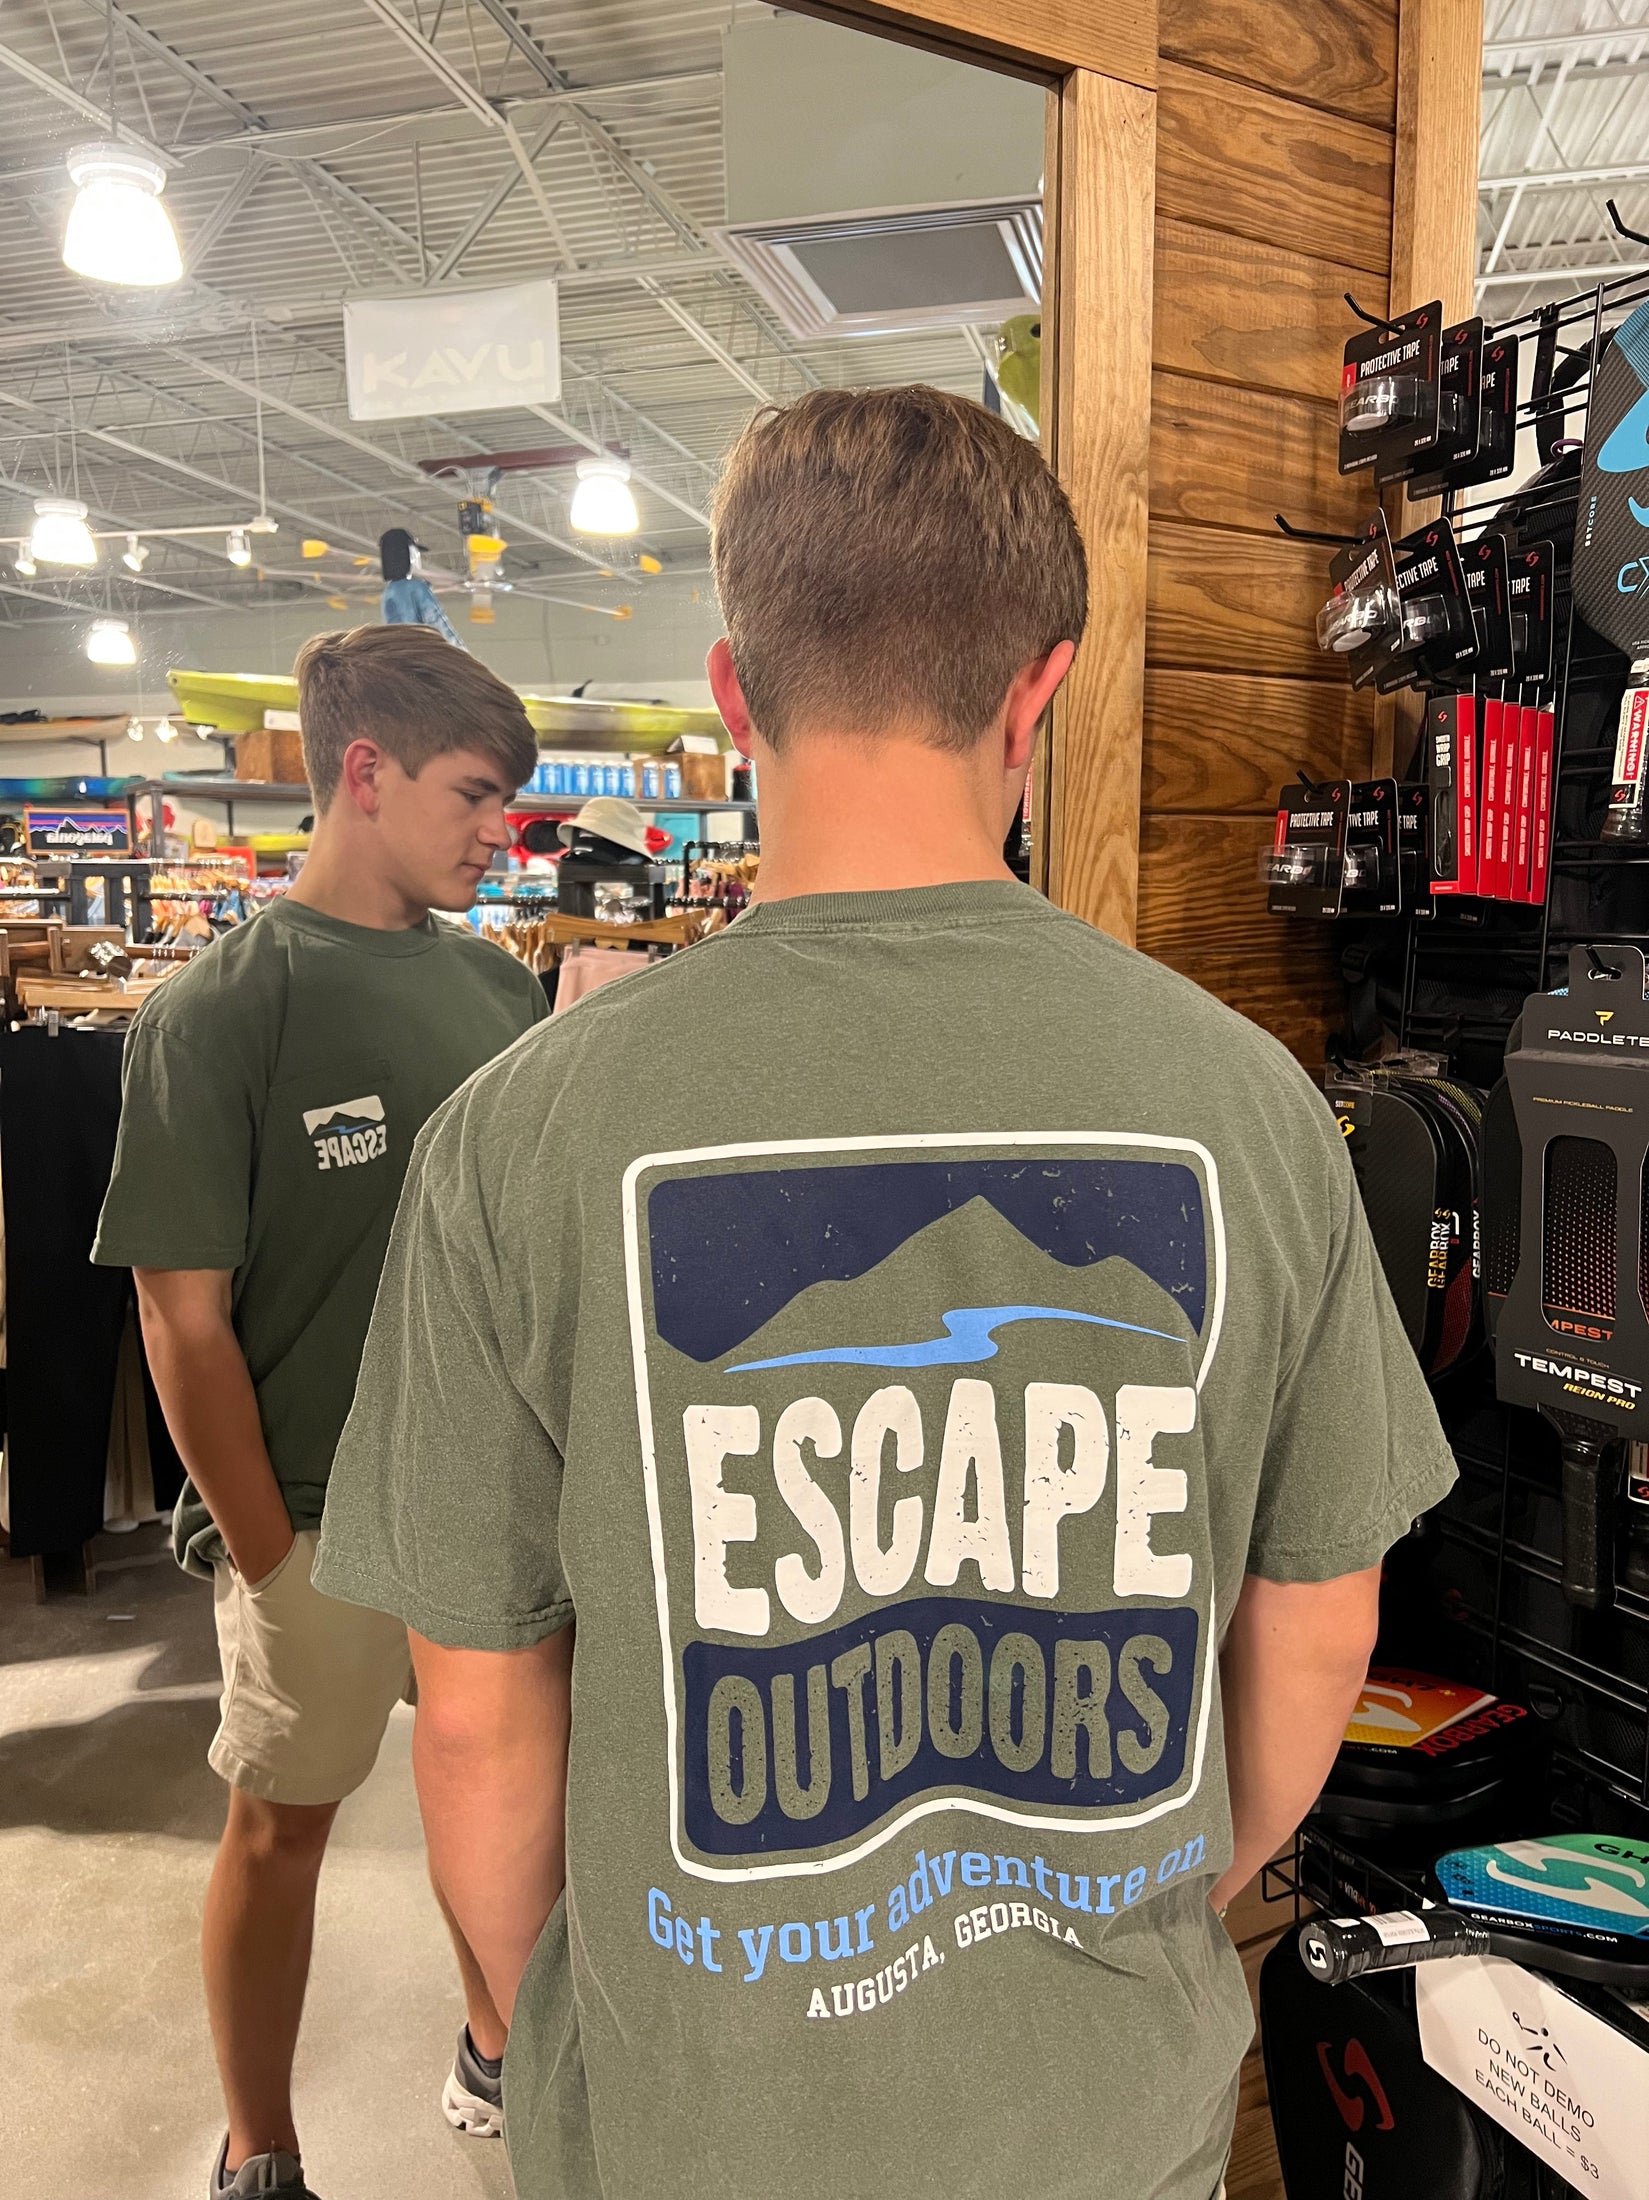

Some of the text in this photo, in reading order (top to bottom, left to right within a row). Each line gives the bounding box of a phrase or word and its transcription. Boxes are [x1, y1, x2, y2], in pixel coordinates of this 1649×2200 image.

[362, 338, 545, 394] KAVU
[1360, 348, 1402, 378] PROTECTIVE
[1403, 339, 1421, 360] TAPE
[1367, 548, 1380, 568] TAPE
[1418, 556, 1439, 579] TAPE
[1467, 570, 1486, 589] TAPE
[1511, 576, 1531, 595] TAPE
[1290, 811, 1335, 828] PROTECTIVE TAPE
[1363, 810, 1379, 826] TAPE
[1403, 815, 1418, 829] TAPE
[1532, 1097, 1633, 1113] PREMIUM PICKLEBALL PADDLE
[1514, 1352, 1642, 1399] TEMPEST
[1546, 1348, 1578, 1361] CONTROL
[1586, 1358, 1610, 1369] TOUCH
[1606, 1395, 1636, 1410] PRO
[682, 1378, 1197, 1636] ESCAPE
[707, 1623, 1173, 1826] OUTDOORS
[1413, 1704, 1528, 1757] GEARBOX
[647, 1886, 723, 1974] Get
[737, 1902, 876, 1984] your
[887, 1848, 1147, 1934] adventure
[1155, 1831, 1206, 1885] on
[806, 1901, 1085, 2020] AUGUSTA, GEORGIA
[1478, 2028, 1595, 2128] DO NOT DEMO
[1490, 2059, 1581, 2142] NEW BALLS
[1475, 2069, 1517, 2112] EACH
[1522, 2106, 1561, 2149] BALL
[1580, 2155, 1600, 2180] $3
